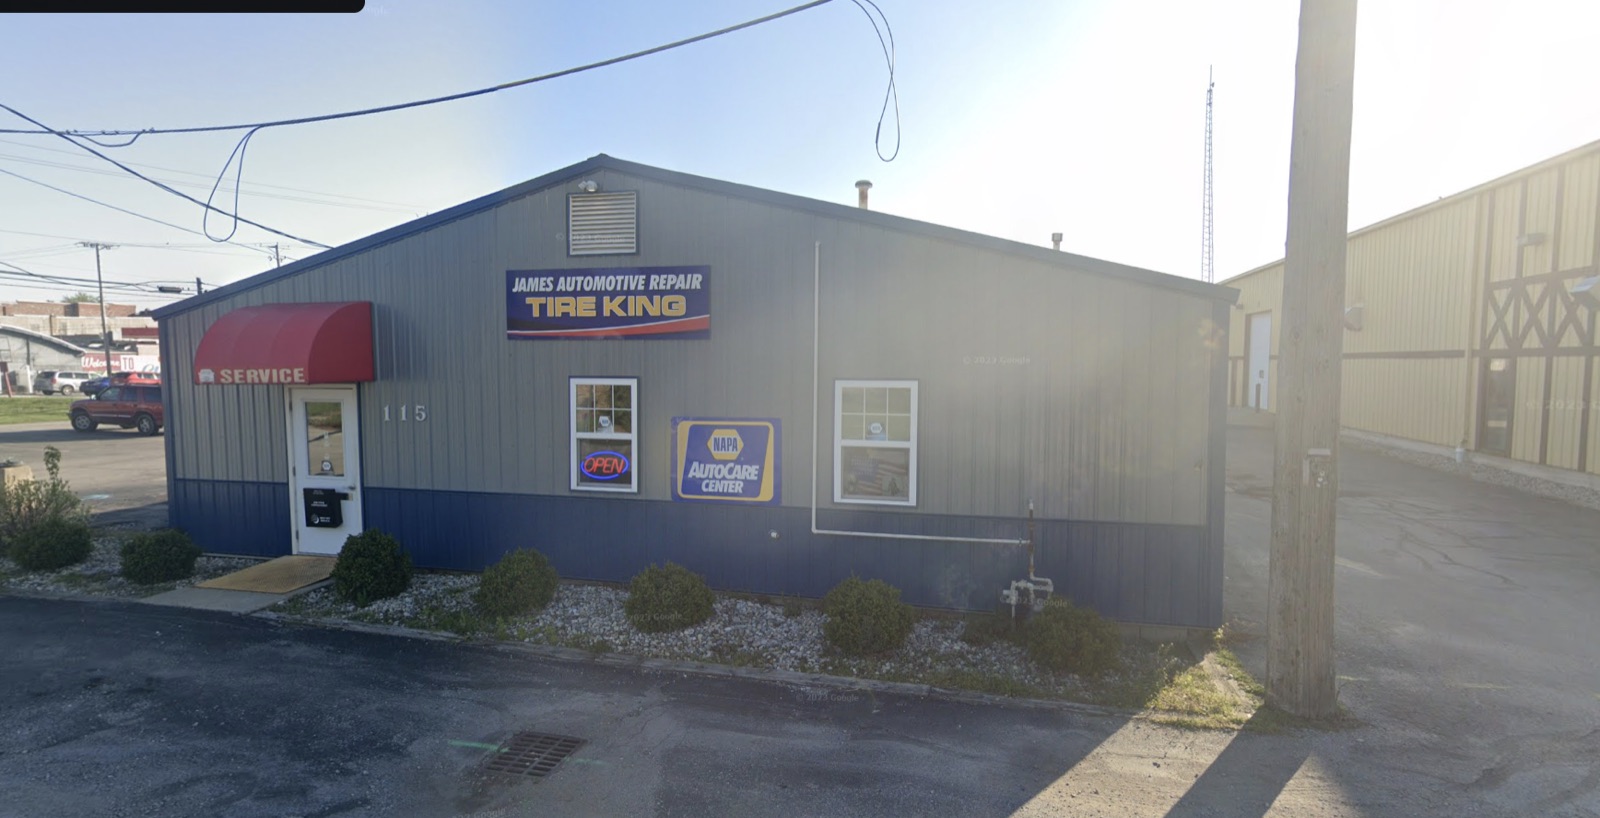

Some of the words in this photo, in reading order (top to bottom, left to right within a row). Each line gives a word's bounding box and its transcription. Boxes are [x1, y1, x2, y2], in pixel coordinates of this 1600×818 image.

[512, 277, 553, 292] JAMES
[556, 275, 646, 292] AUTOMOTIVE
[649, 273, 702, 290] REPAIR
[525, 296, 597, 317] TIRE
[603, 295, 687, 317] KING
[122, 357, 134, 370] TO
[220, 368, 305, 384] SERVICE
[384, 405, 426, 421] 115
[713, 436, 738, 452] NAPA
[584, 457, 625, 474] OPEN
[688, 461, 759, 480] AUTOCARE
[701, 479, 743, 493] CENTER
